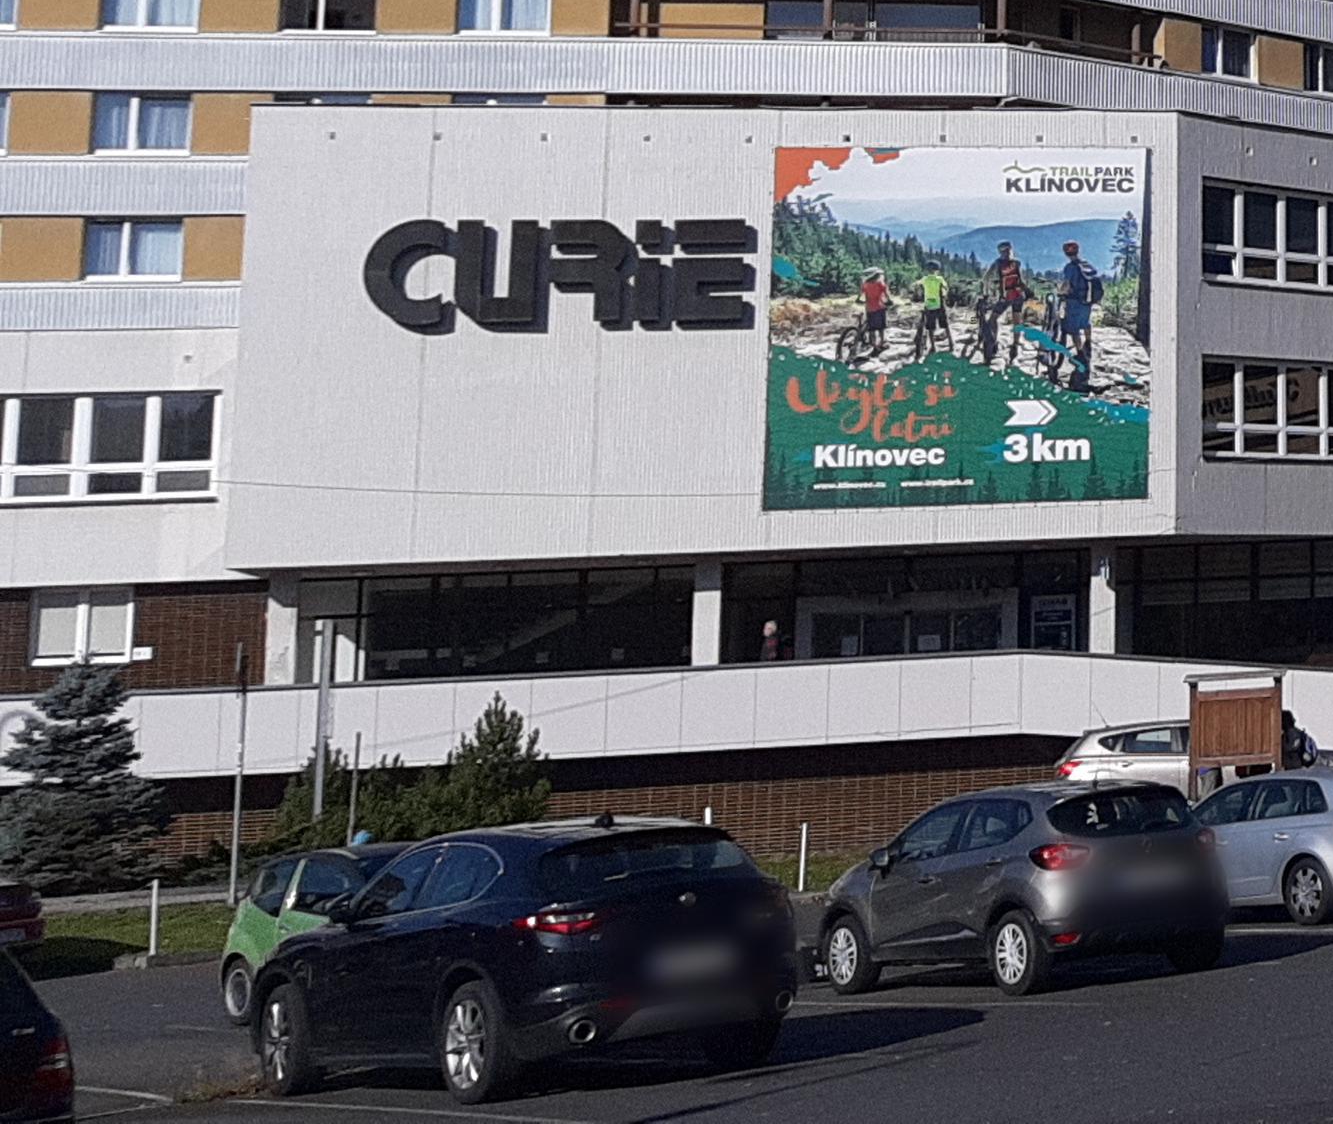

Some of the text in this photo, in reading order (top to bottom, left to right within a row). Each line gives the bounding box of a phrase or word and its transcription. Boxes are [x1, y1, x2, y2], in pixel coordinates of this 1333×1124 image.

[1006, 173, 1134, 193] KLÍNOVEC
[814, 443, 945, 468] Klínovec
[1003, 432, 1091, 463] 3 km
